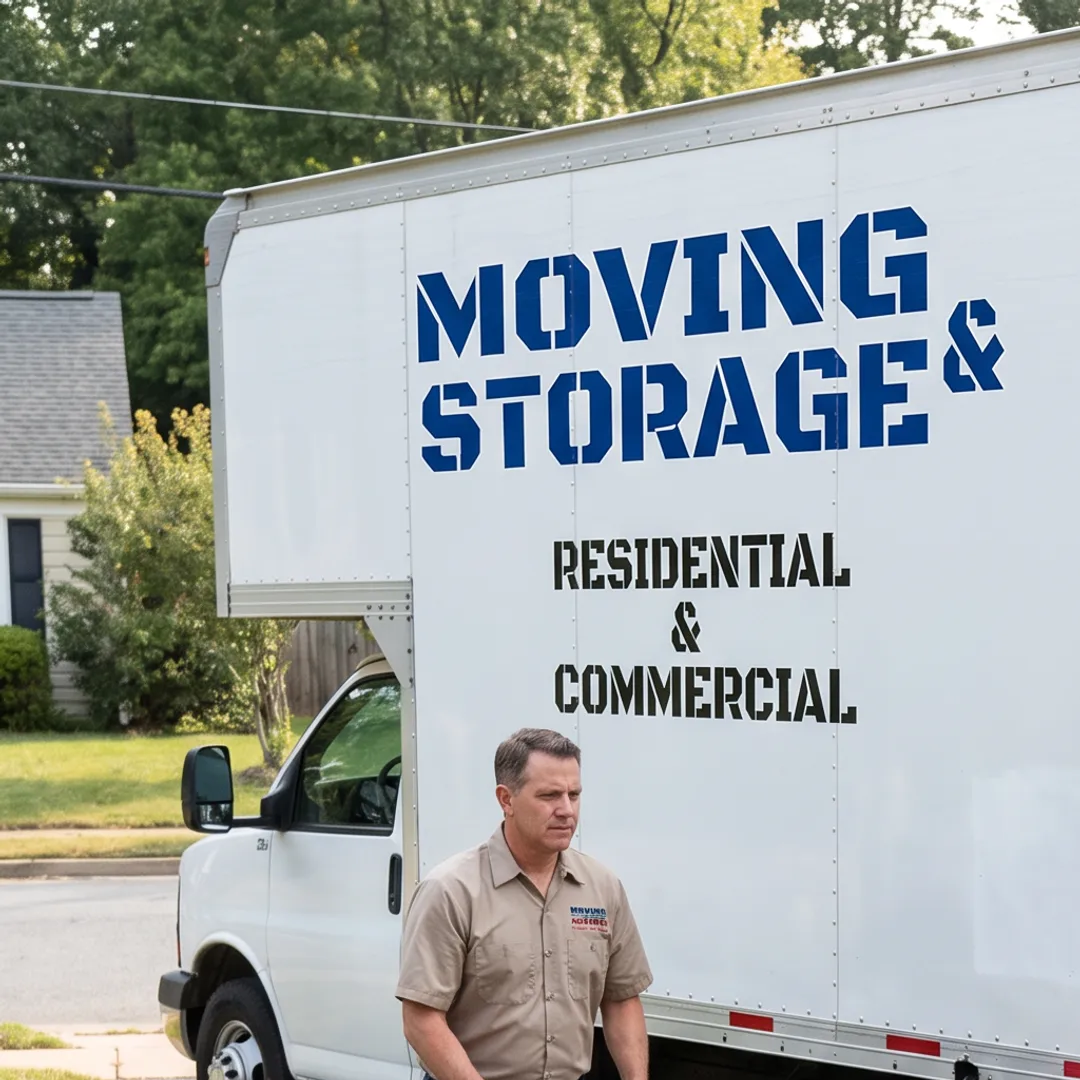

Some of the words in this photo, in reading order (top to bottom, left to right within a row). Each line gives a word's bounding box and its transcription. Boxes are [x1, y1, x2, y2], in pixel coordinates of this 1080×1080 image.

[416, 207, 928, 363] MOVING
[421, 340, 929, 472] STORAGE
[943, 299, 1004, 393] &
[554, 532, 851, 590] RESIDENTIAL
[671, 601, 701, 652] &
[554, 664, 857, 724] COMMERCIAL
